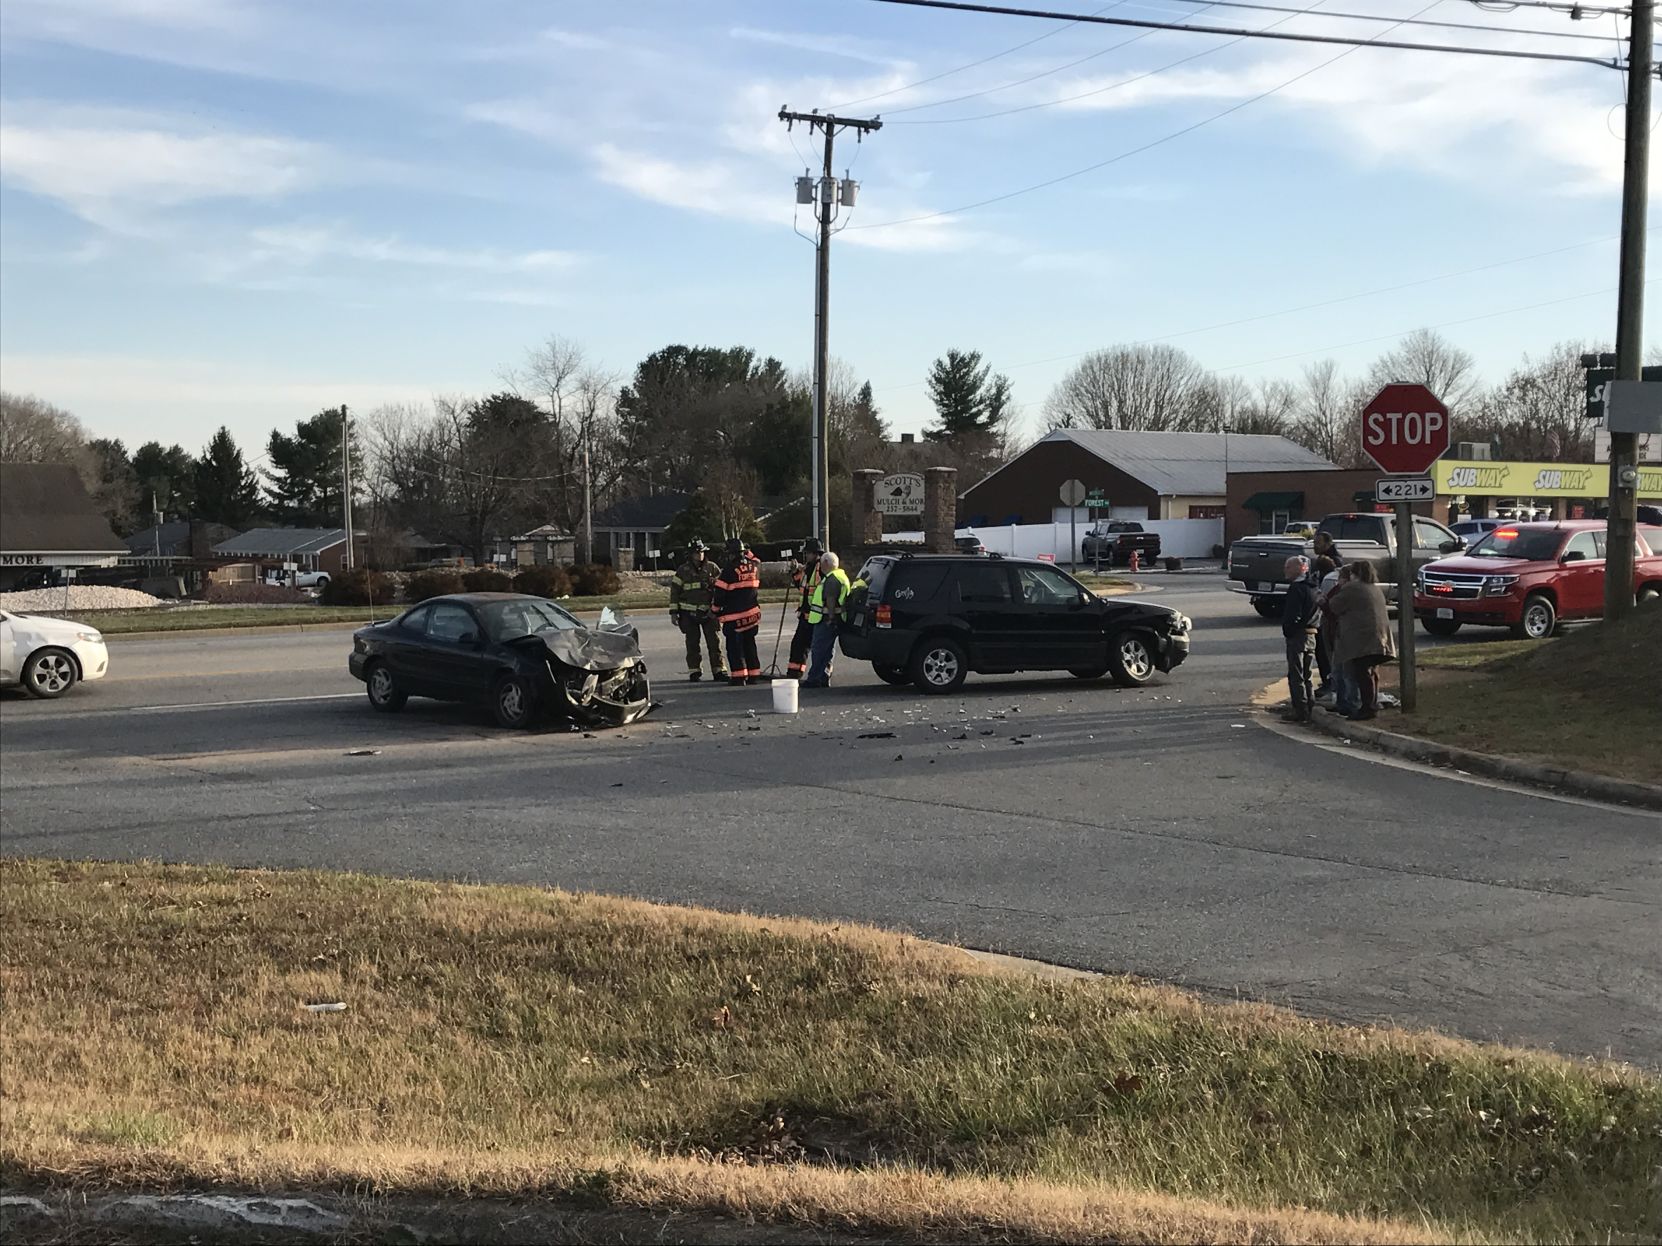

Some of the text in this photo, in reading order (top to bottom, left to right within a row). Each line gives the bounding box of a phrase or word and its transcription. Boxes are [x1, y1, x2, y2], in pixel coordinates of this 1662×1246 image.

[1368, 412, 1443, 445] STOP
[884, 477, 921, 488] SCOTT'S
[1448, 465, 1510, 489] SUBWAY
[1534, 468, 1593, 491] SUBWAY
[1395, 484, 1418, 496] 221
[877, 498, 901, 506] MULCH
[1085, 499, 1104, 507] FOREST
[2, 555, 44, 565] MORE
